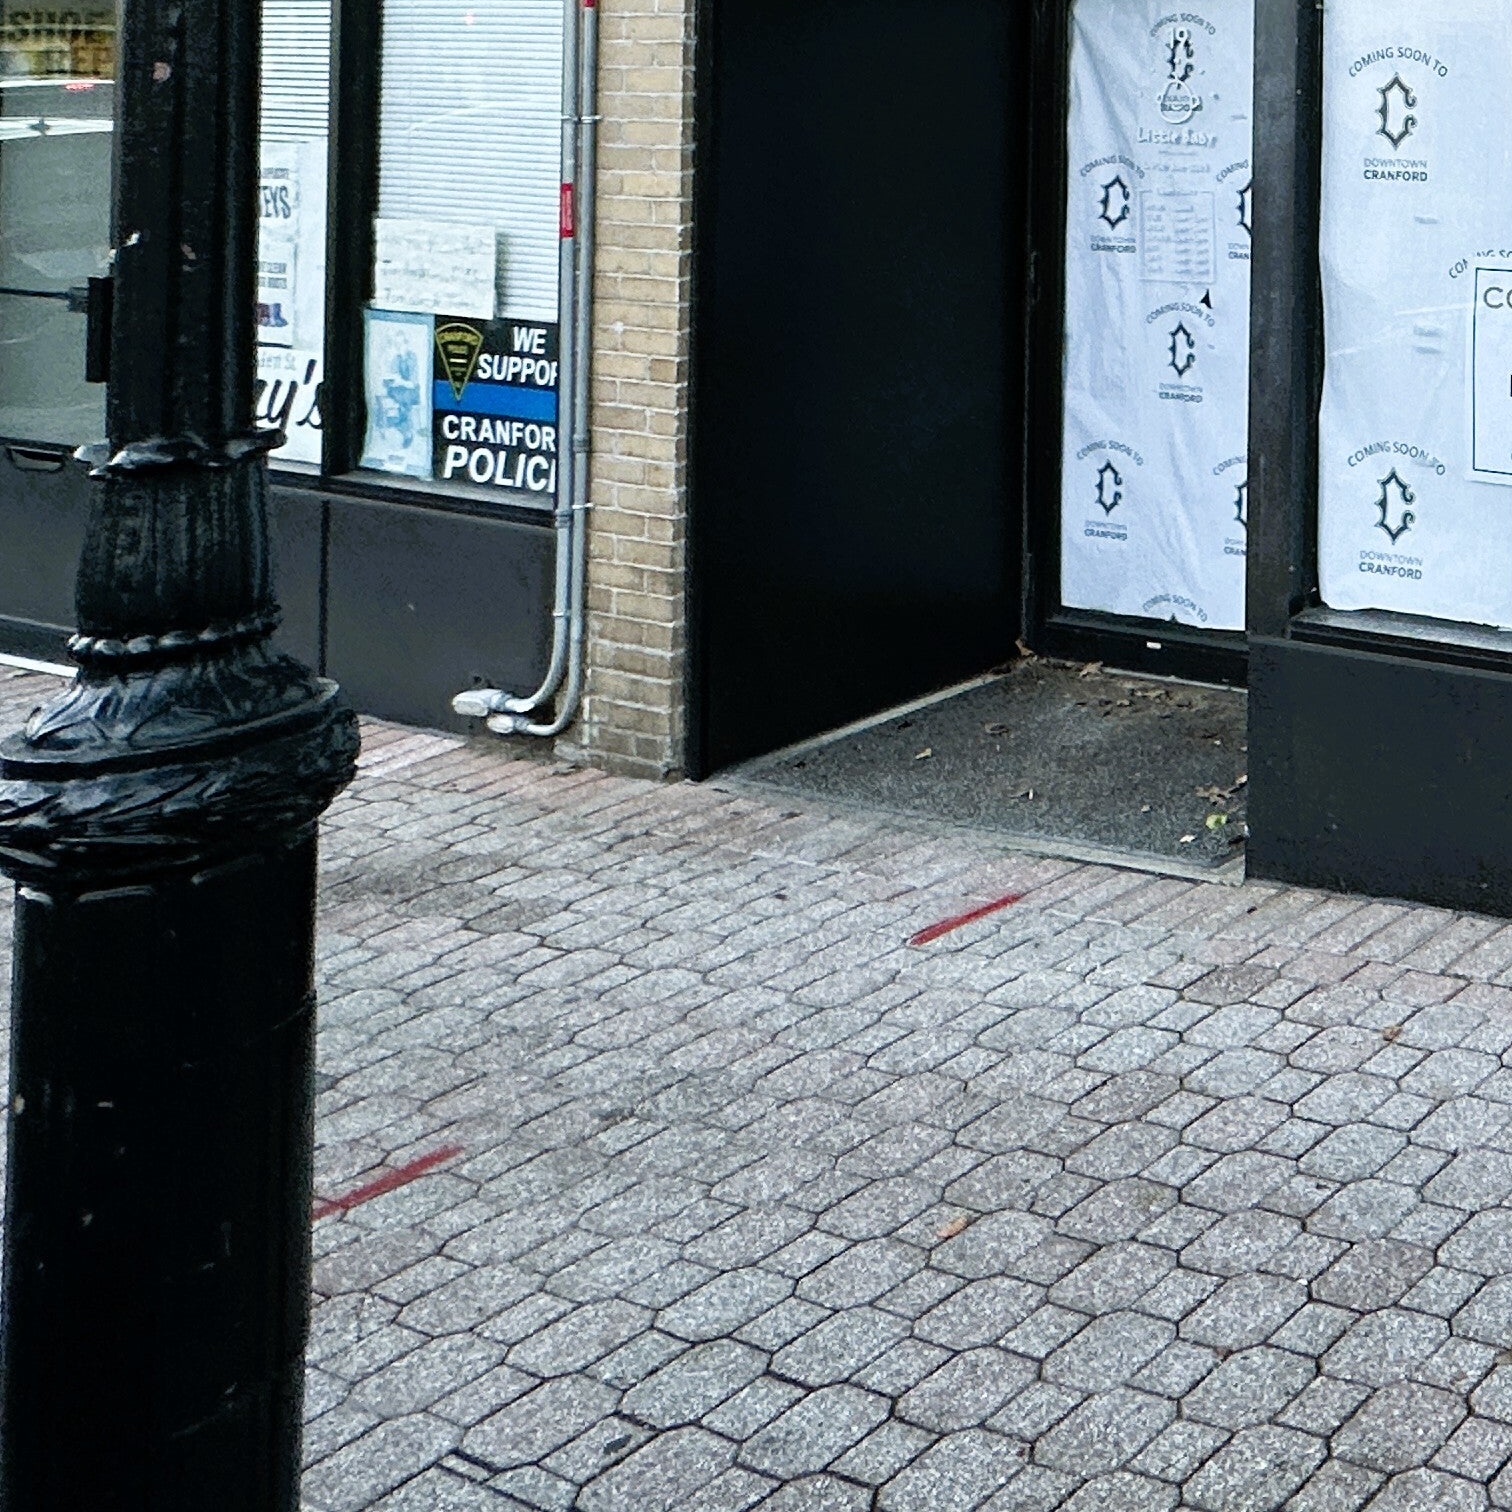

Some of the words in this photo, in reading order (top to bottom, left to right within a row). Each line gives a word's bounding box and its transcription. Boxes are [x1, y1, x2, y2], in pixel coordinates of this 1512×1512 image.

[1349, 47, 1394, 78] COMING
[1397, 47, 1431, 66] SOON
[1432, 59, 1448, 78] TO
[1363, 169, 1428, 182] CRANFORD
[1364, 158, 1427, 169] DOWNTOWN
[513, 326, 548, 355] WE
[443, 445, 556, 493] POLIC
